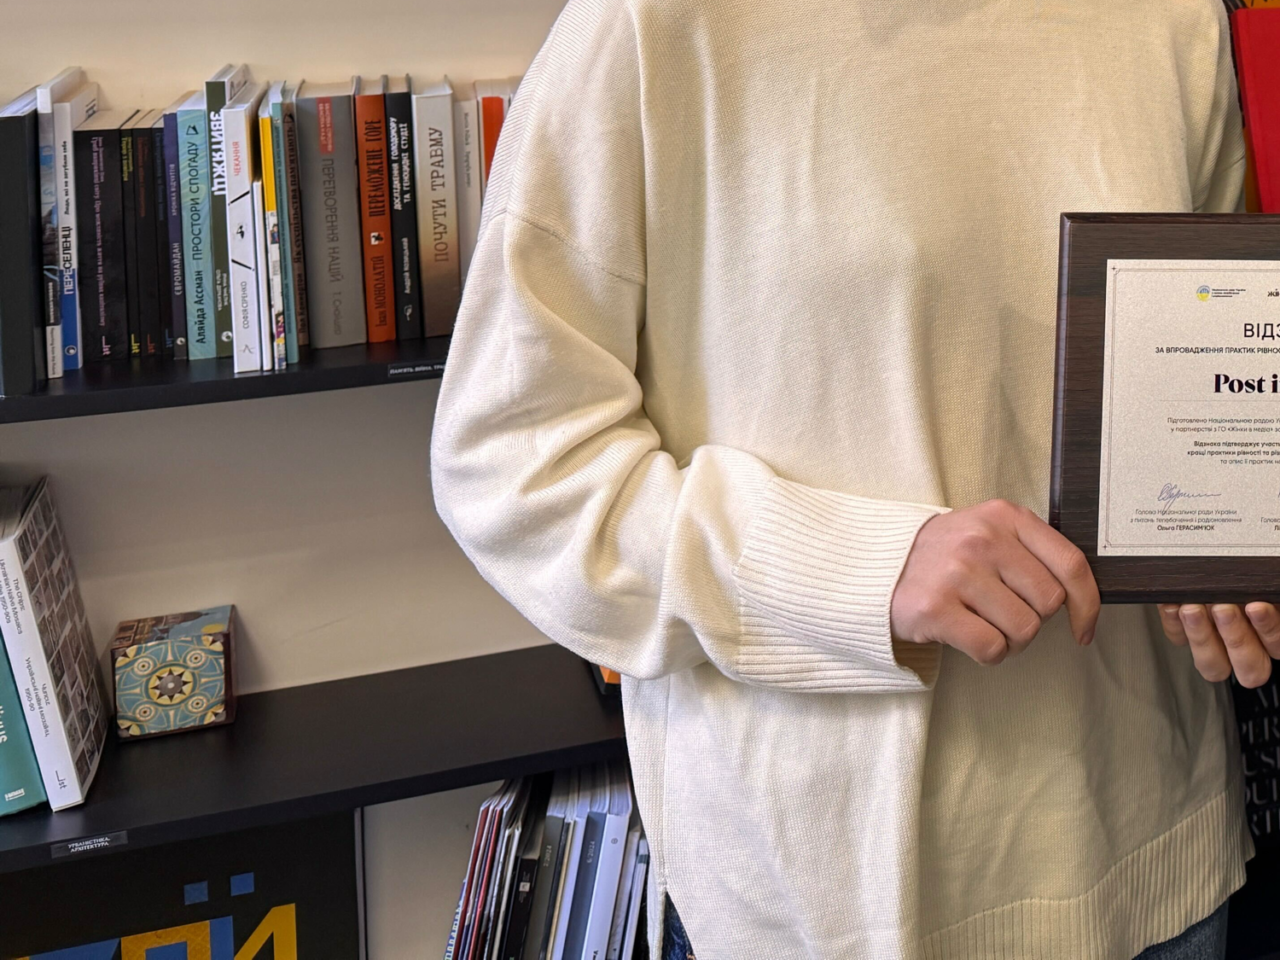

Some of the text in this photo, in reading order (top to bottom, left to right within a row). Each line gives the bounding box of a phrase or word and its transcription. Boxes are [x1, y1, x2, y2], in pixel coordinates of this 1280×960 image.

[232, 141, 241, 177] ЧЕКАННЯ
[365, 119, 386, 218] ПЕРЕМОЖЕНЕ ГОРЕ
[322, 158, 346, 284] ПЕРЕТВОРЕННЯ НАЦІЙ
[428, 127, 449, 263] ПОЧУТИ ТРАВМУ
[61, 226, 74, 295] ПЕРЕСЕЛЕНЦІ
[188, 141, 207, 345] Аляйда Ассман ПРОСТОРИ СПОГАДУ
[371, 255, 387, 308] МОНОЛАТІЙ
[1166, 347, 1224, 355] ВПРОВАДЖЕННЯ
[1214, 373, 1266, 394] Post
